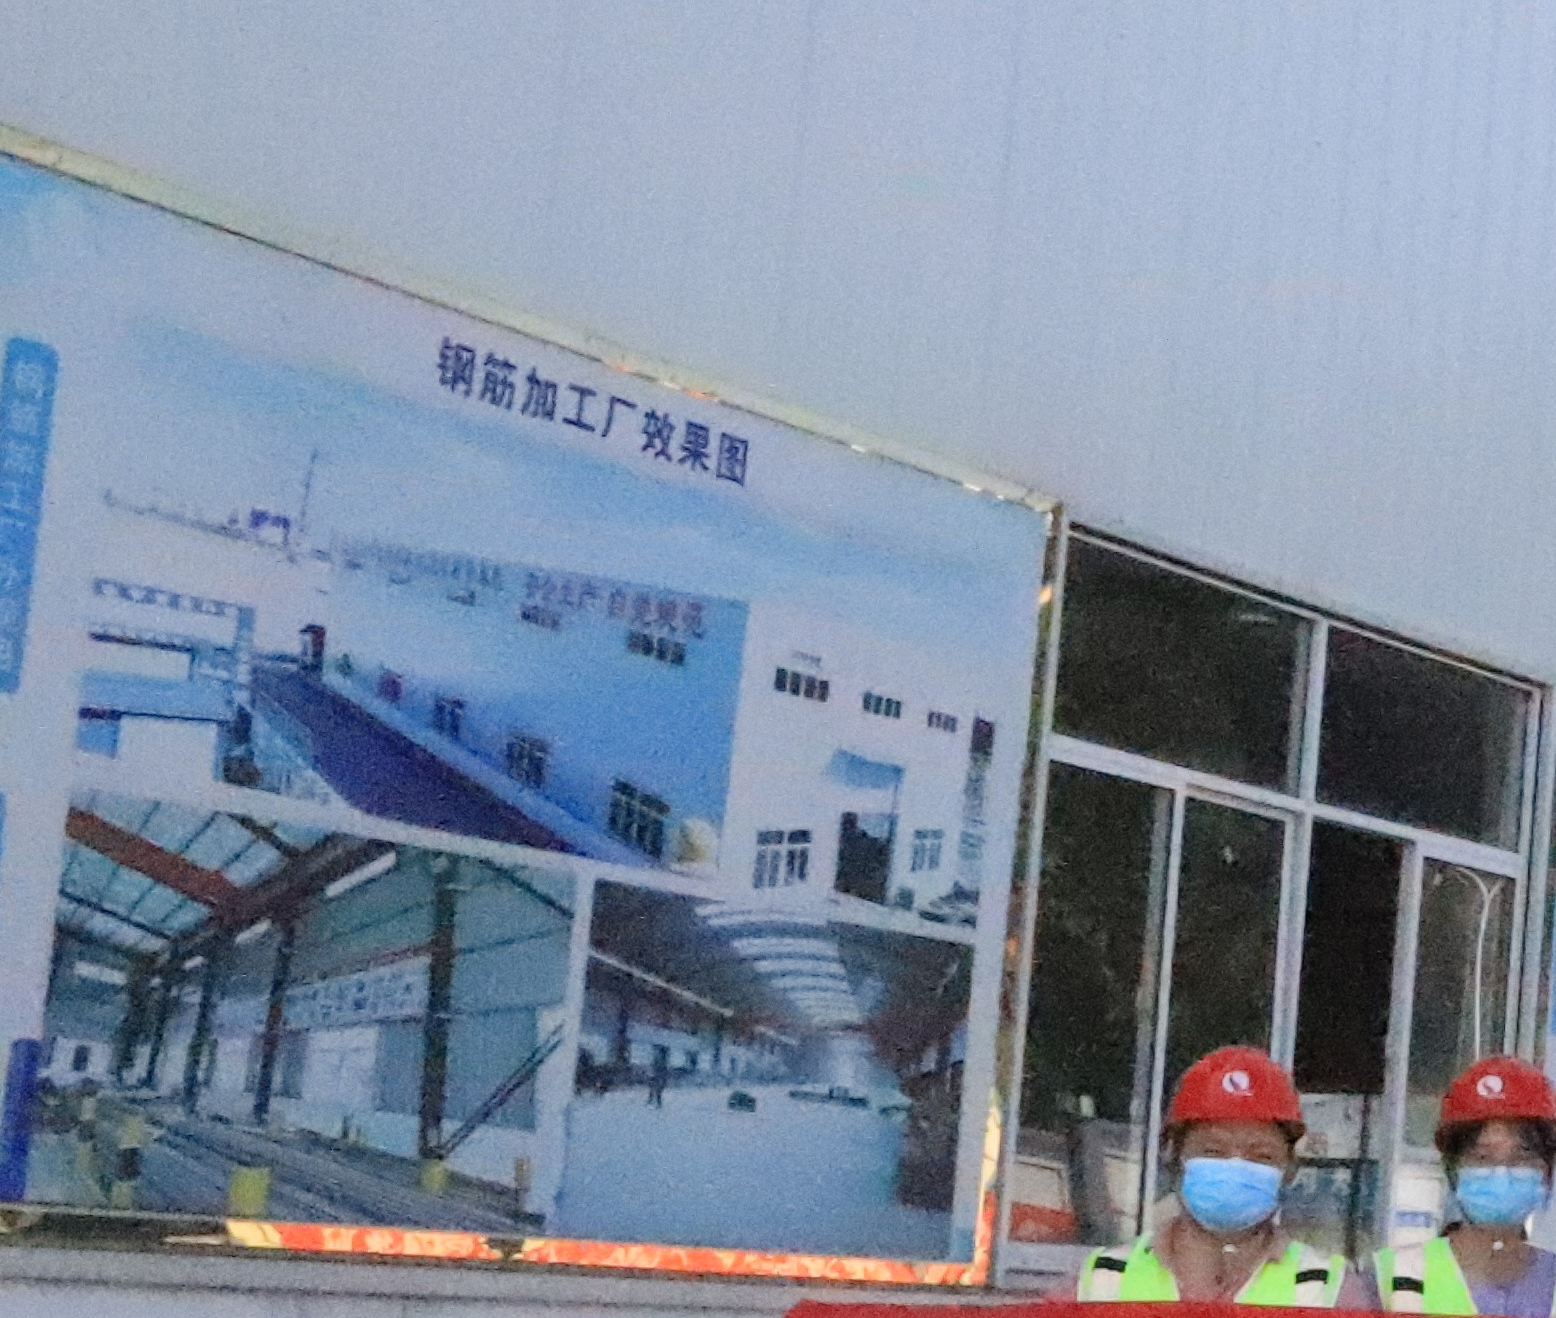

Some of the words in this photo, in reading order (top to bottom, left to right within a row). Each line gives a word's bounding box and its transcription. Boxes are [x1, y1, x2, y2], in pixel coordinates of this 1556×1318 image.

[438, 336, 748, 487] 钢筋加工厂效果图
